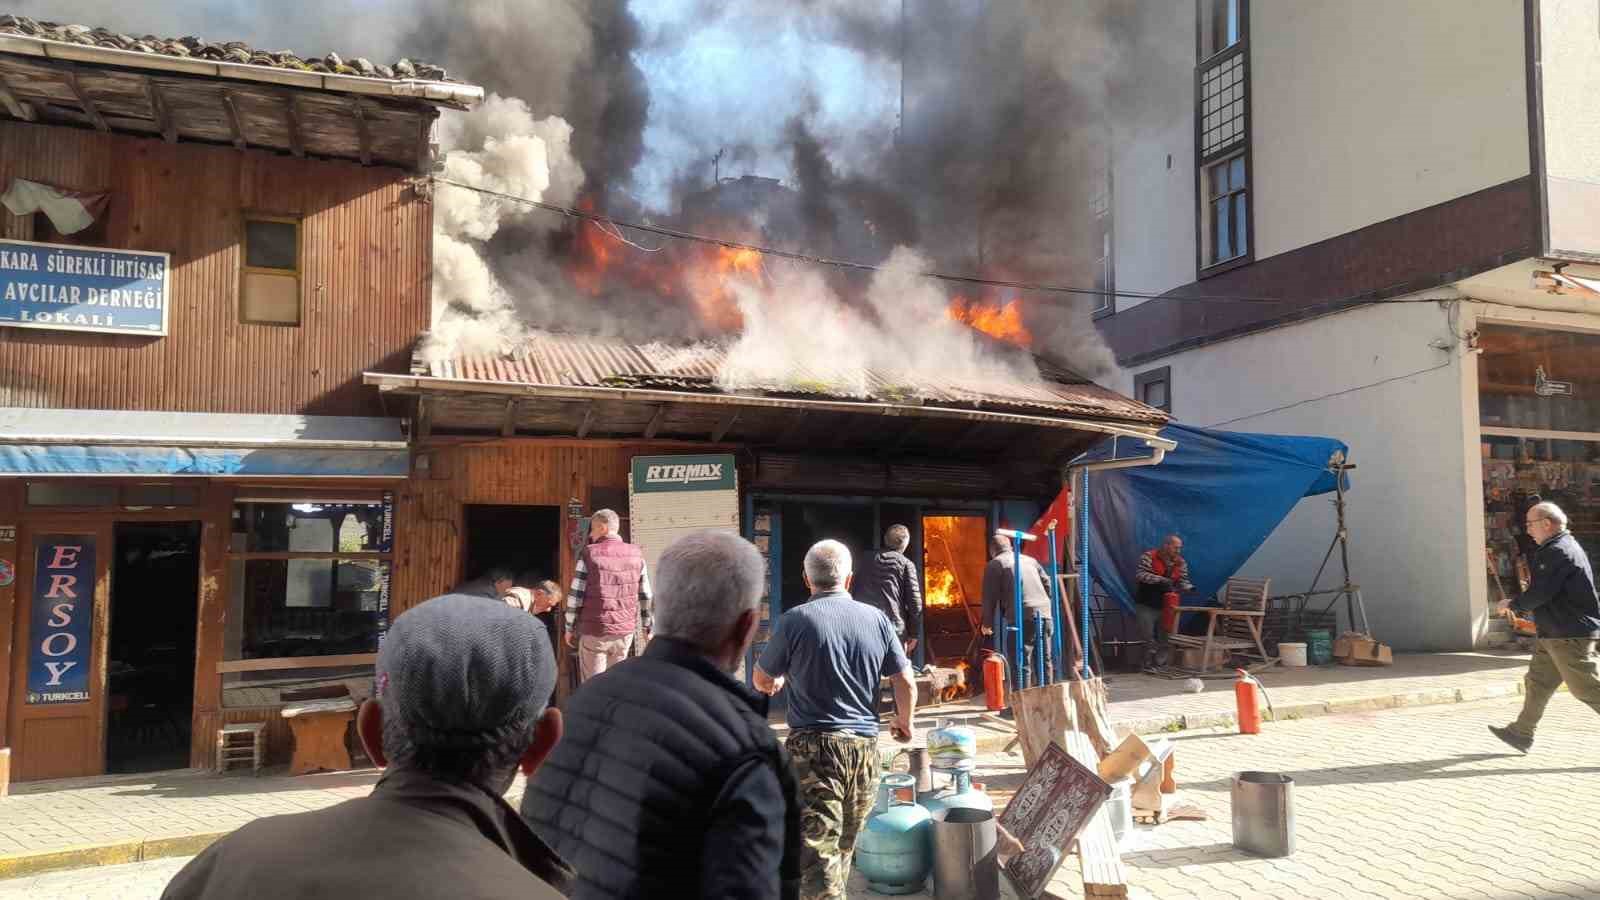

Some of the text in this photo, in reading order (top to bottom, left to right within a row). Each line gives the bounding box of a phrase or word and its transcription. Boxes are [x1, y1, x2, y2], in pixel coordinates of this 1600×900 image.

[47, 250, 105, 276] SÜREKLİ
[110, 254, 163, 280] İHTİSAS
[5, 281, 161, 310] AVCILAR DERNEĞİ
[20, 310, 113, 326] LOKALİ
[646, 463, 722, 484] RTRMAX
[41, 545, 82, 686] ERSOY
[41, 691, 90, 702] TURKCELL
